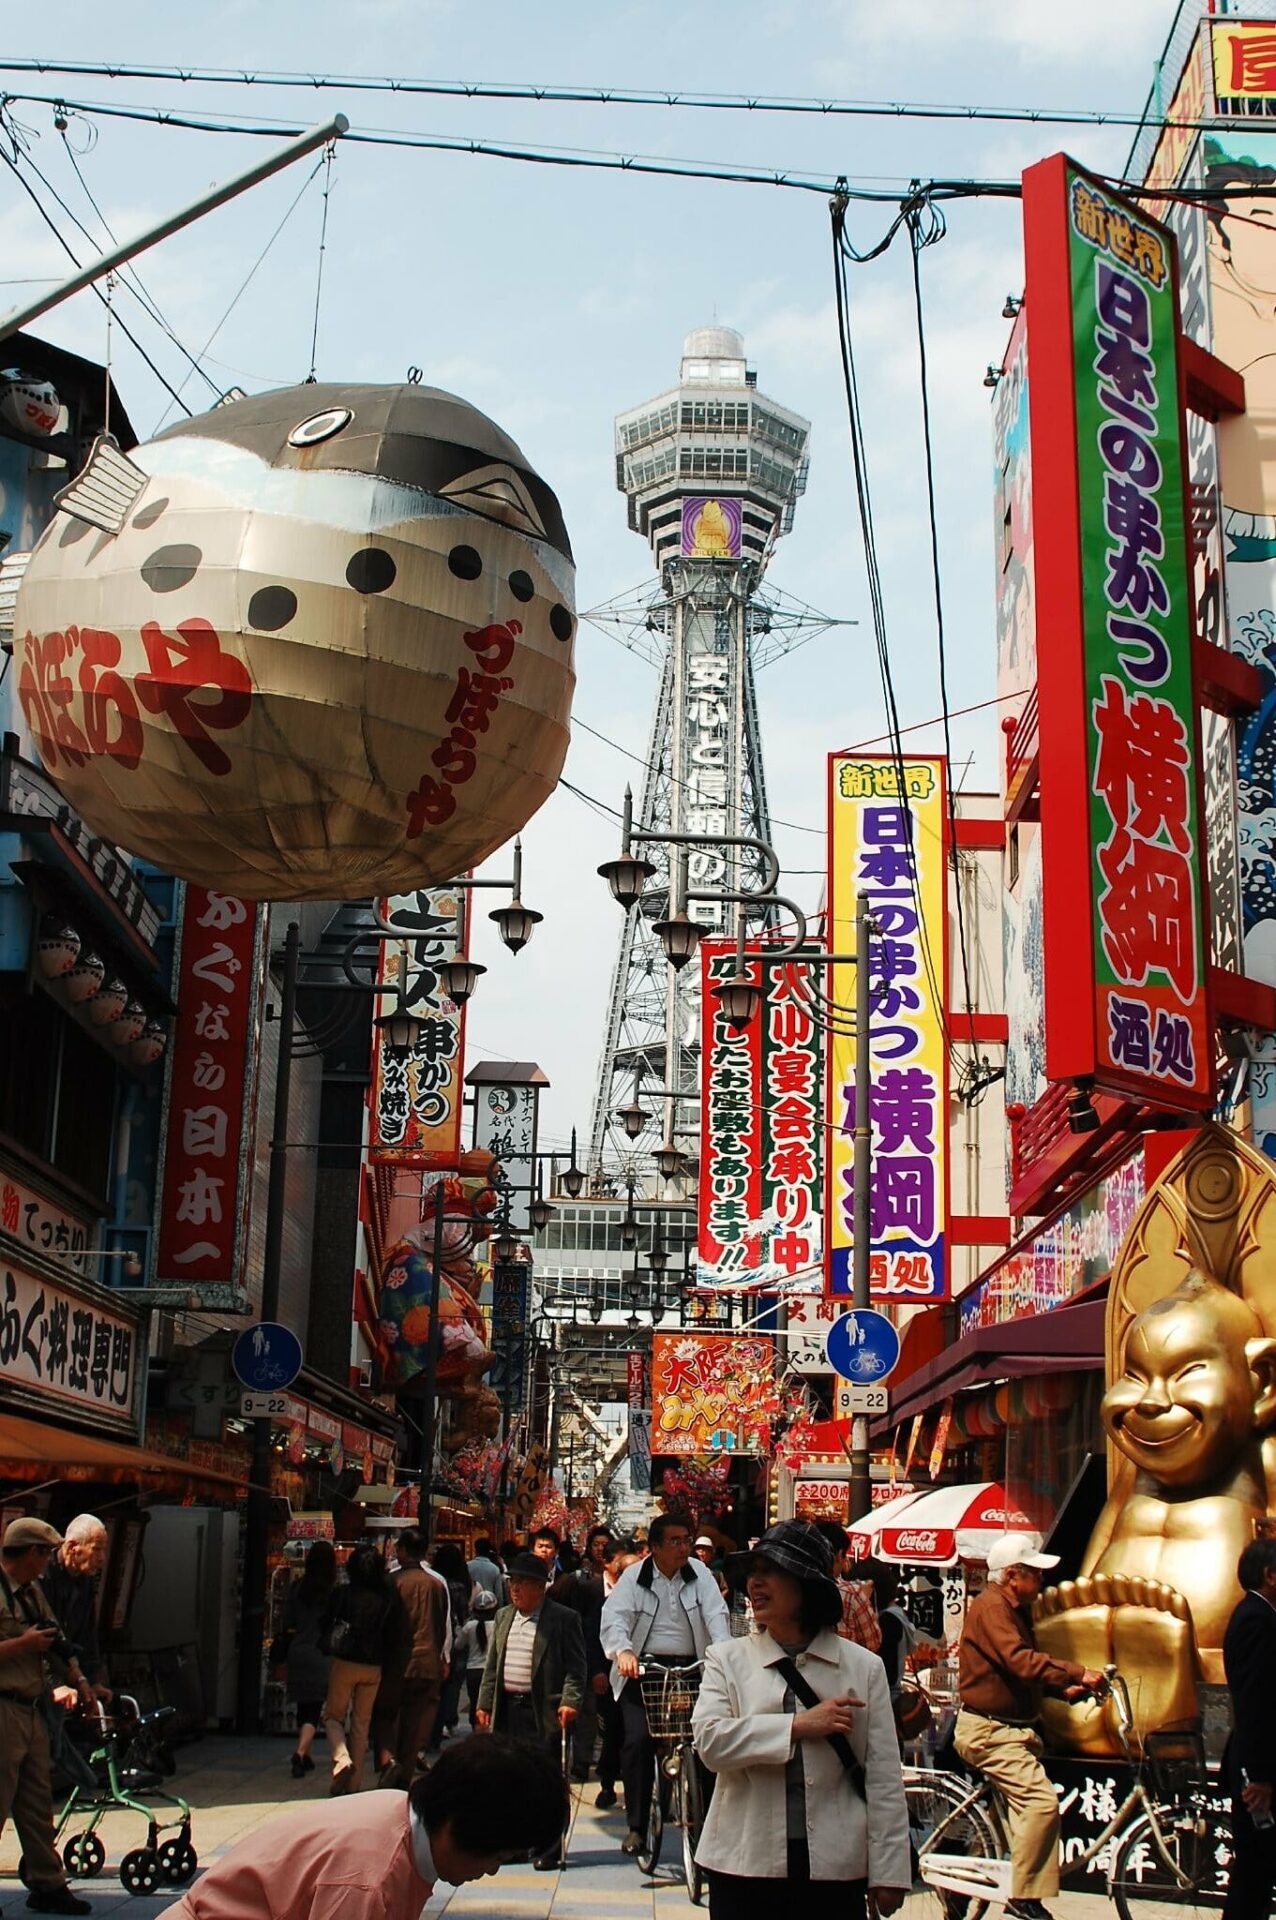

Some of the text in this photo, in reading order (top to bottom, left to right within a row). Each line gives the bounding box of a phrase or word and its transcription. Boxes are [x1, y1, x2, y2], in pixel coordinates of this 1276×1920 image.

[1072, 184, 1166, 287] 新世界
[1095, 262, 1171, 686] 日本一の串かつ
[406, 618, 523, 840] づぼらや
[839, 765, 935, 800] 新世界
[1095, 678, 1198, 1002] 横綱
[850, 805, 922, 1061] 日本一の串かつ
[413, 1016, 458, 1125] 串かつ
[1111, 994, 1195, 1082] 酒処
[708, 954, 752, 1274] 広したお座敷もあります!!
[769, 957, 814, 1274] 大小宴会承り中
[839, 1069, 936, 1240] 横綱
[864, 1252, 932, 1290] 酒処
[179, 1383, 241, 1405] くすり
[243, 1398, 286, 1413] 9-22
[662, 1342, 735, 1396] 大阪
[841, 1392, 885, 1409] 9-22
